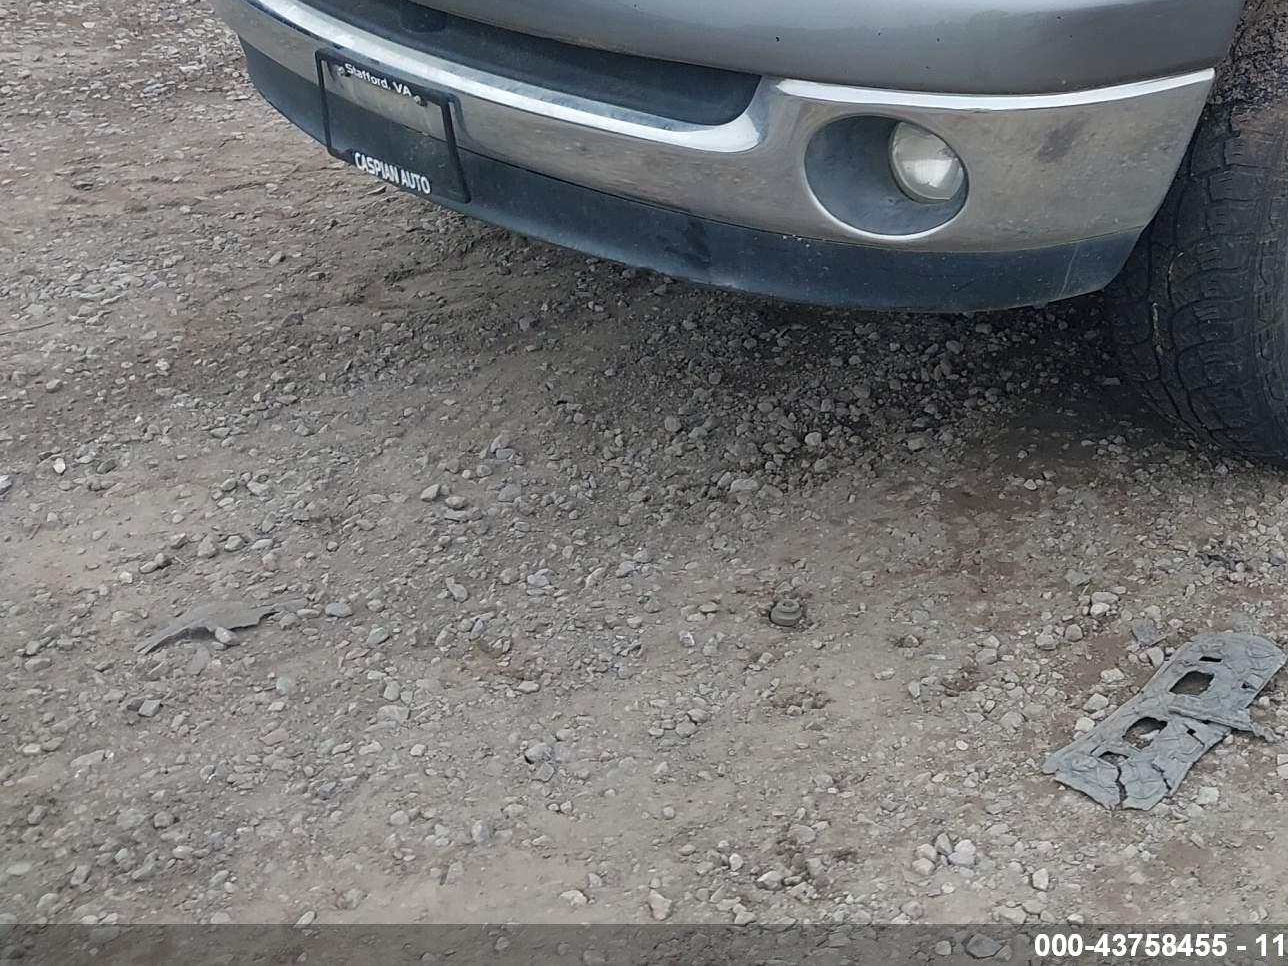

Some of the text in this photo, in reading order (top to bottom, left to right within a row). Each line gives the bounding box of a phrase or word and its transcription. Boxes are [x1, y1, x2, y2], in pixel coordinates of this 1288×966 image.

[392, 81, 412, 97] VA
[354, 152, 432, 194] CASPIAN AUTO
